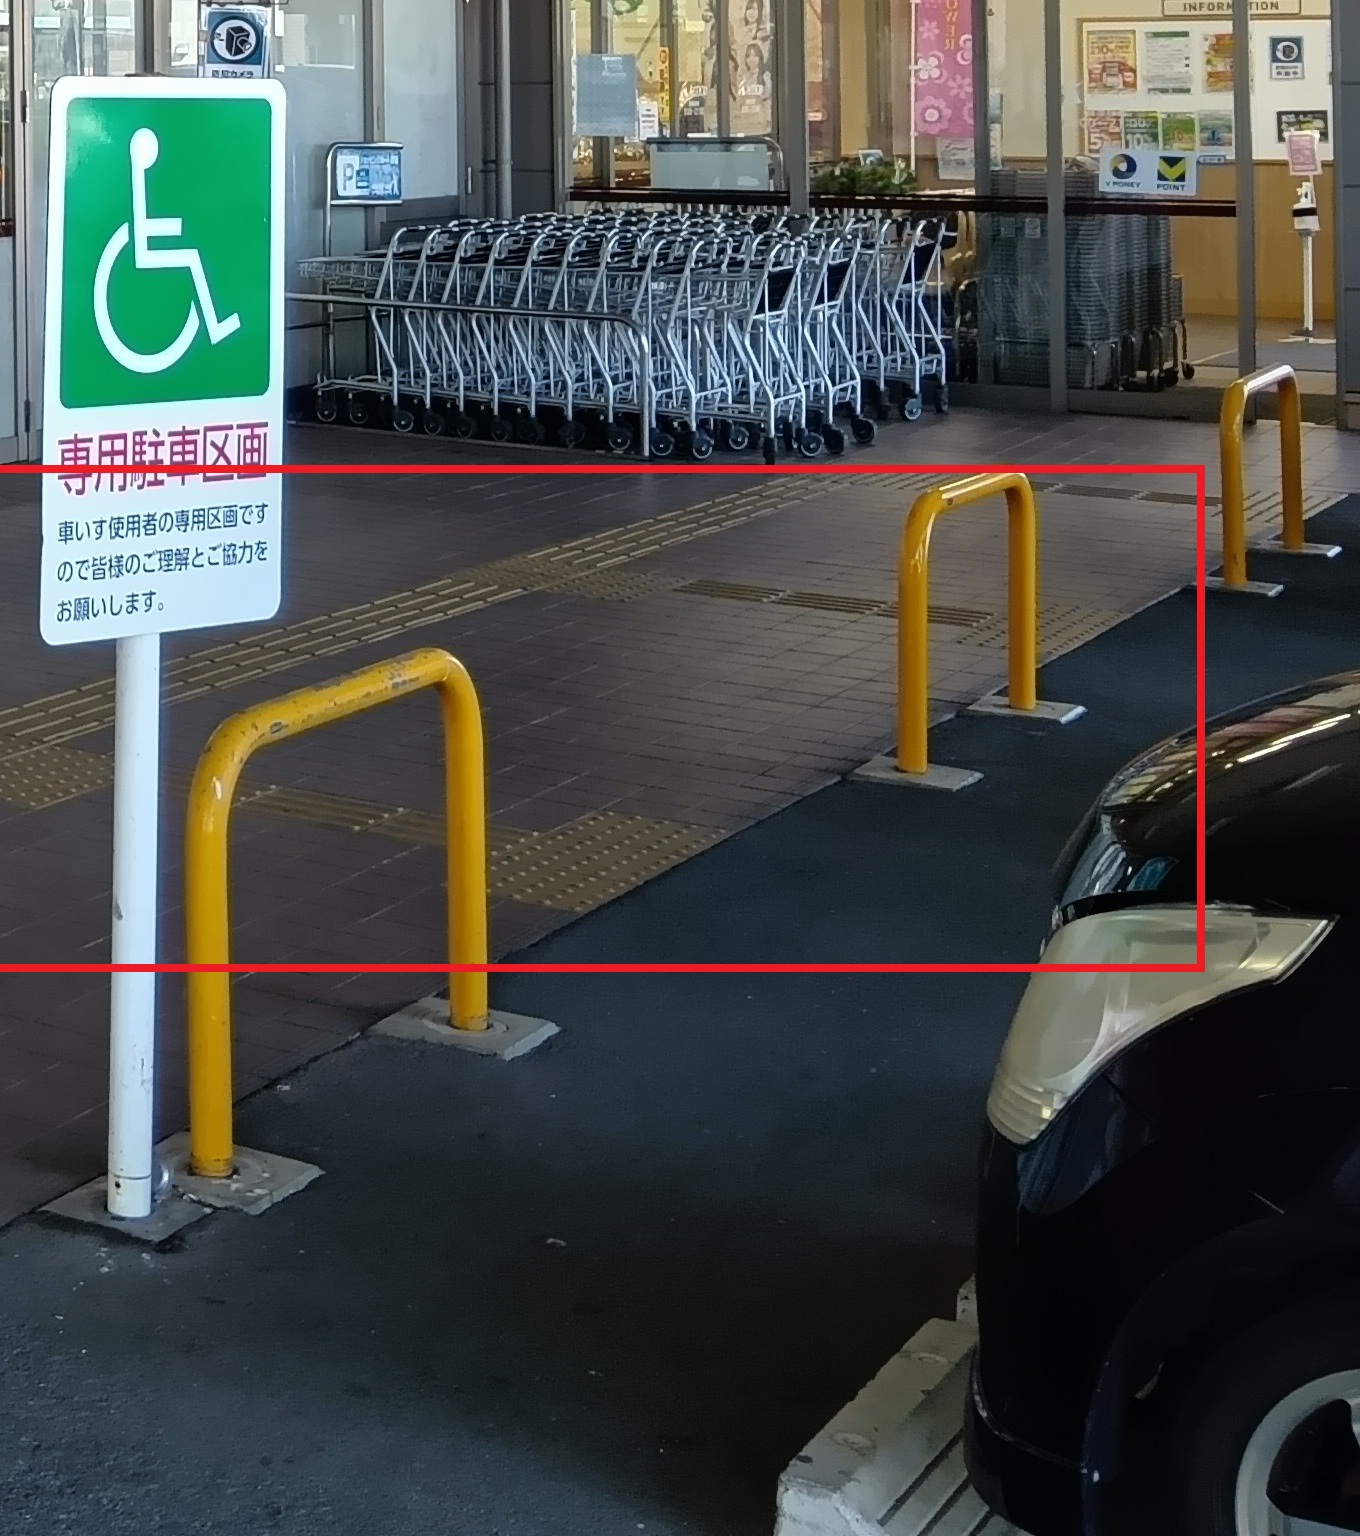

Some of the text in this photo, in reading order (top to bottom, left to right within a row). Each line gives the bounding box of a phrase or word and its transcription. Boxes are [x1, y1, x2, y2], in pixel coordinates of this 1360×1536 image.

[1183, 1, 1280, 12] INFORTION
[57, 421, 269, 496] 専用駐車区画
[57, 502, 269, 545] 車いす使用者の専用区画です
[57, 540, 268, 583] ので皆様のご理解とご協力を
[56, 590, 164, 622] お願いします。
